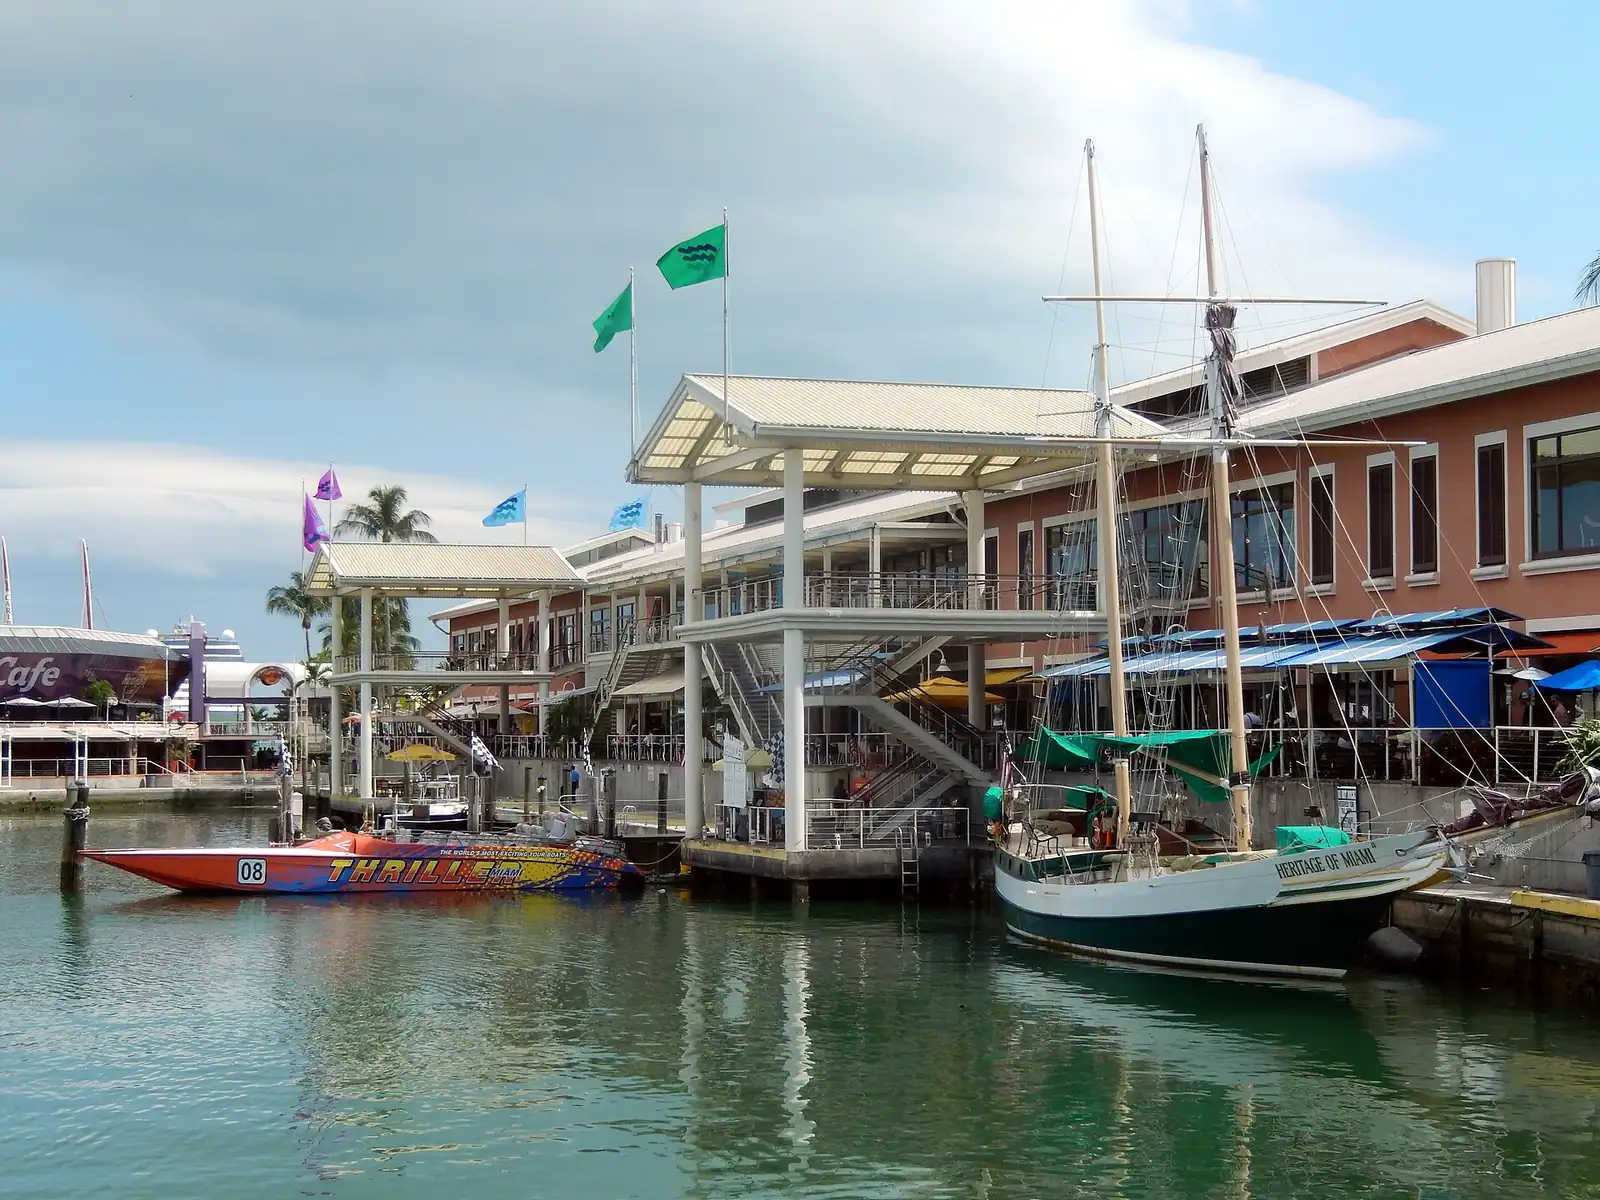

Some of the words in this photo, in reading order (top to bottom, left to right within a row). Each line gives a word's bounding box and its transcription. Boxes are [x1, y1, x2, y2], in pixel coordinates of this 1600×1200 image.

[241, 862, 262, 880] 08
[328, 859, 521, 884] THRILLER
[489, 868, 523, 878] MIAMI
[1275, 856, 1325, 879] HERITAGE
[1324, 853, 1340, 870] OF
[1340, 847, 1376, 868] MIAMI
